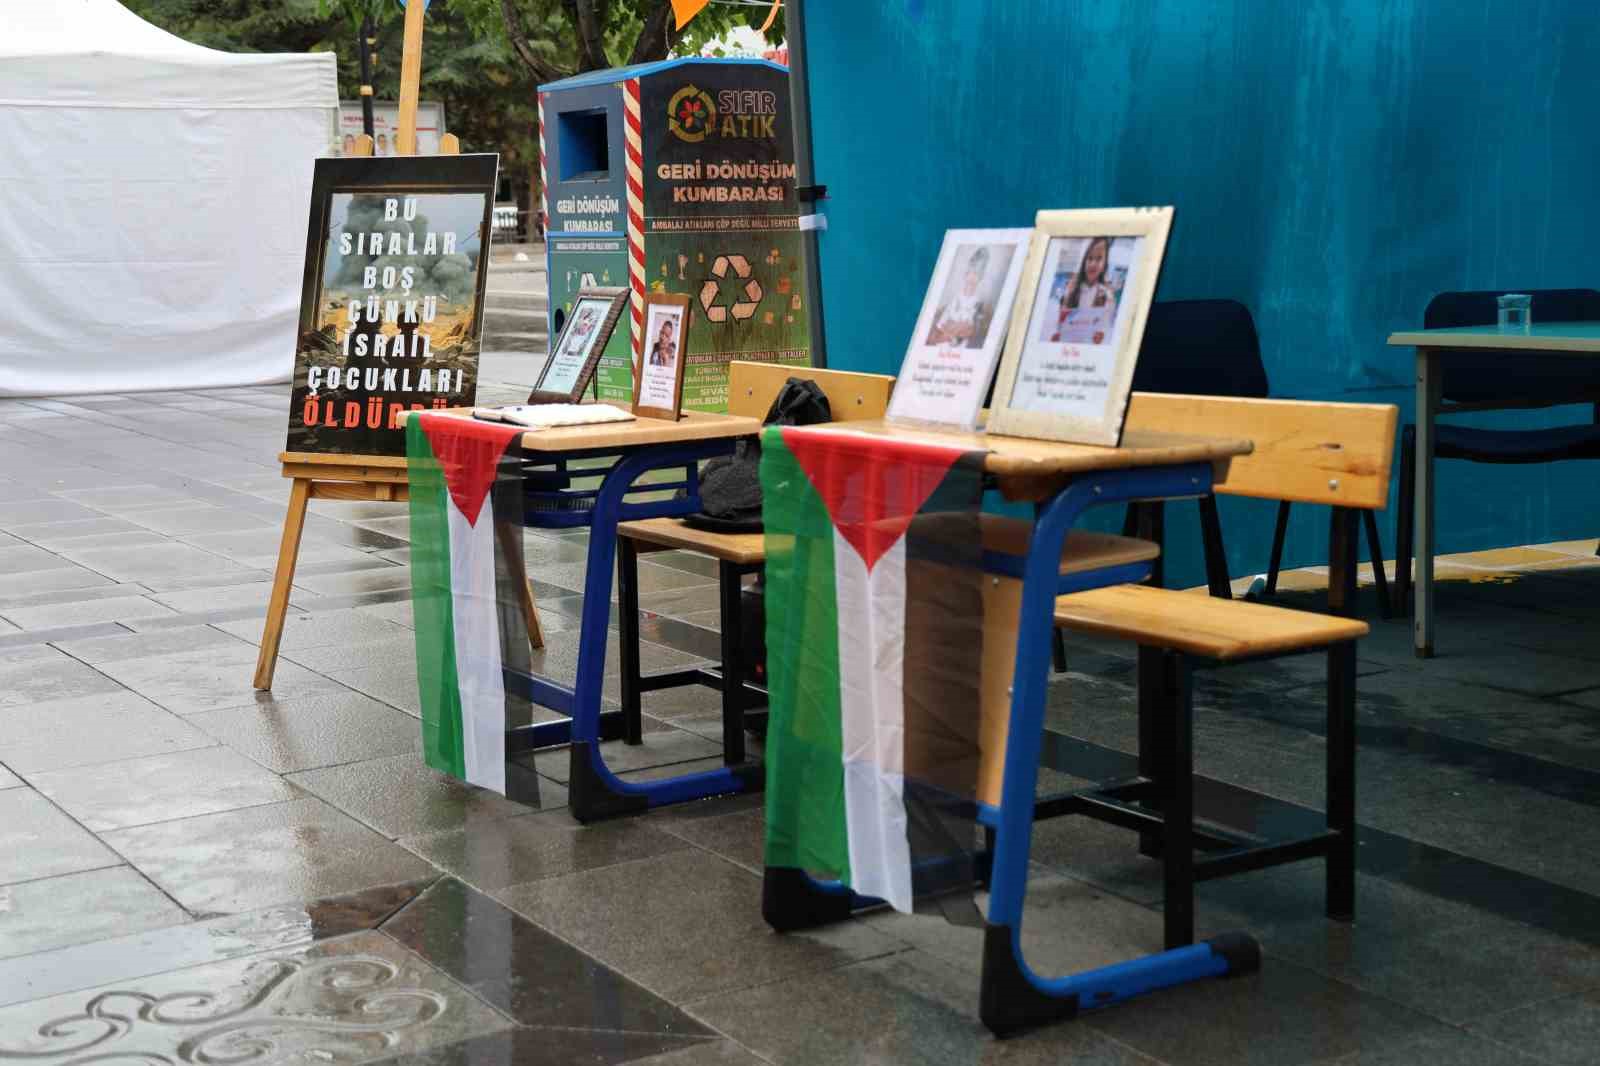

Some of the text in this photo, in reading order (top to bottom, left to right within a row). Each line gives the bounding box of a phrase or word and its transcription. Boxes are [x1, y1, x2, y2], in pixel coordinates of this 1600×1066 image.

[718, 90, 776, 114] SIFIR
[721, 115, 776, 138] ATIK
[657, 160, 796, 183] GERİ DÖNÜŞÜM
[557, 195, 619, 217] GERİ DÖNÜŞÜM
[673, 187, 783, 203] KUMBARASI
[384, 198, 418, 222] BU
[339, 231, 457, 256] SIRALAR
[363, 266, 415, 297] BOŞ
[347, 296, 438, 330] ÇÜNKÜ
[343, 329, 435, 358] İSRAİL
[307, 366, 463, 397] ÇOCUKLARI
